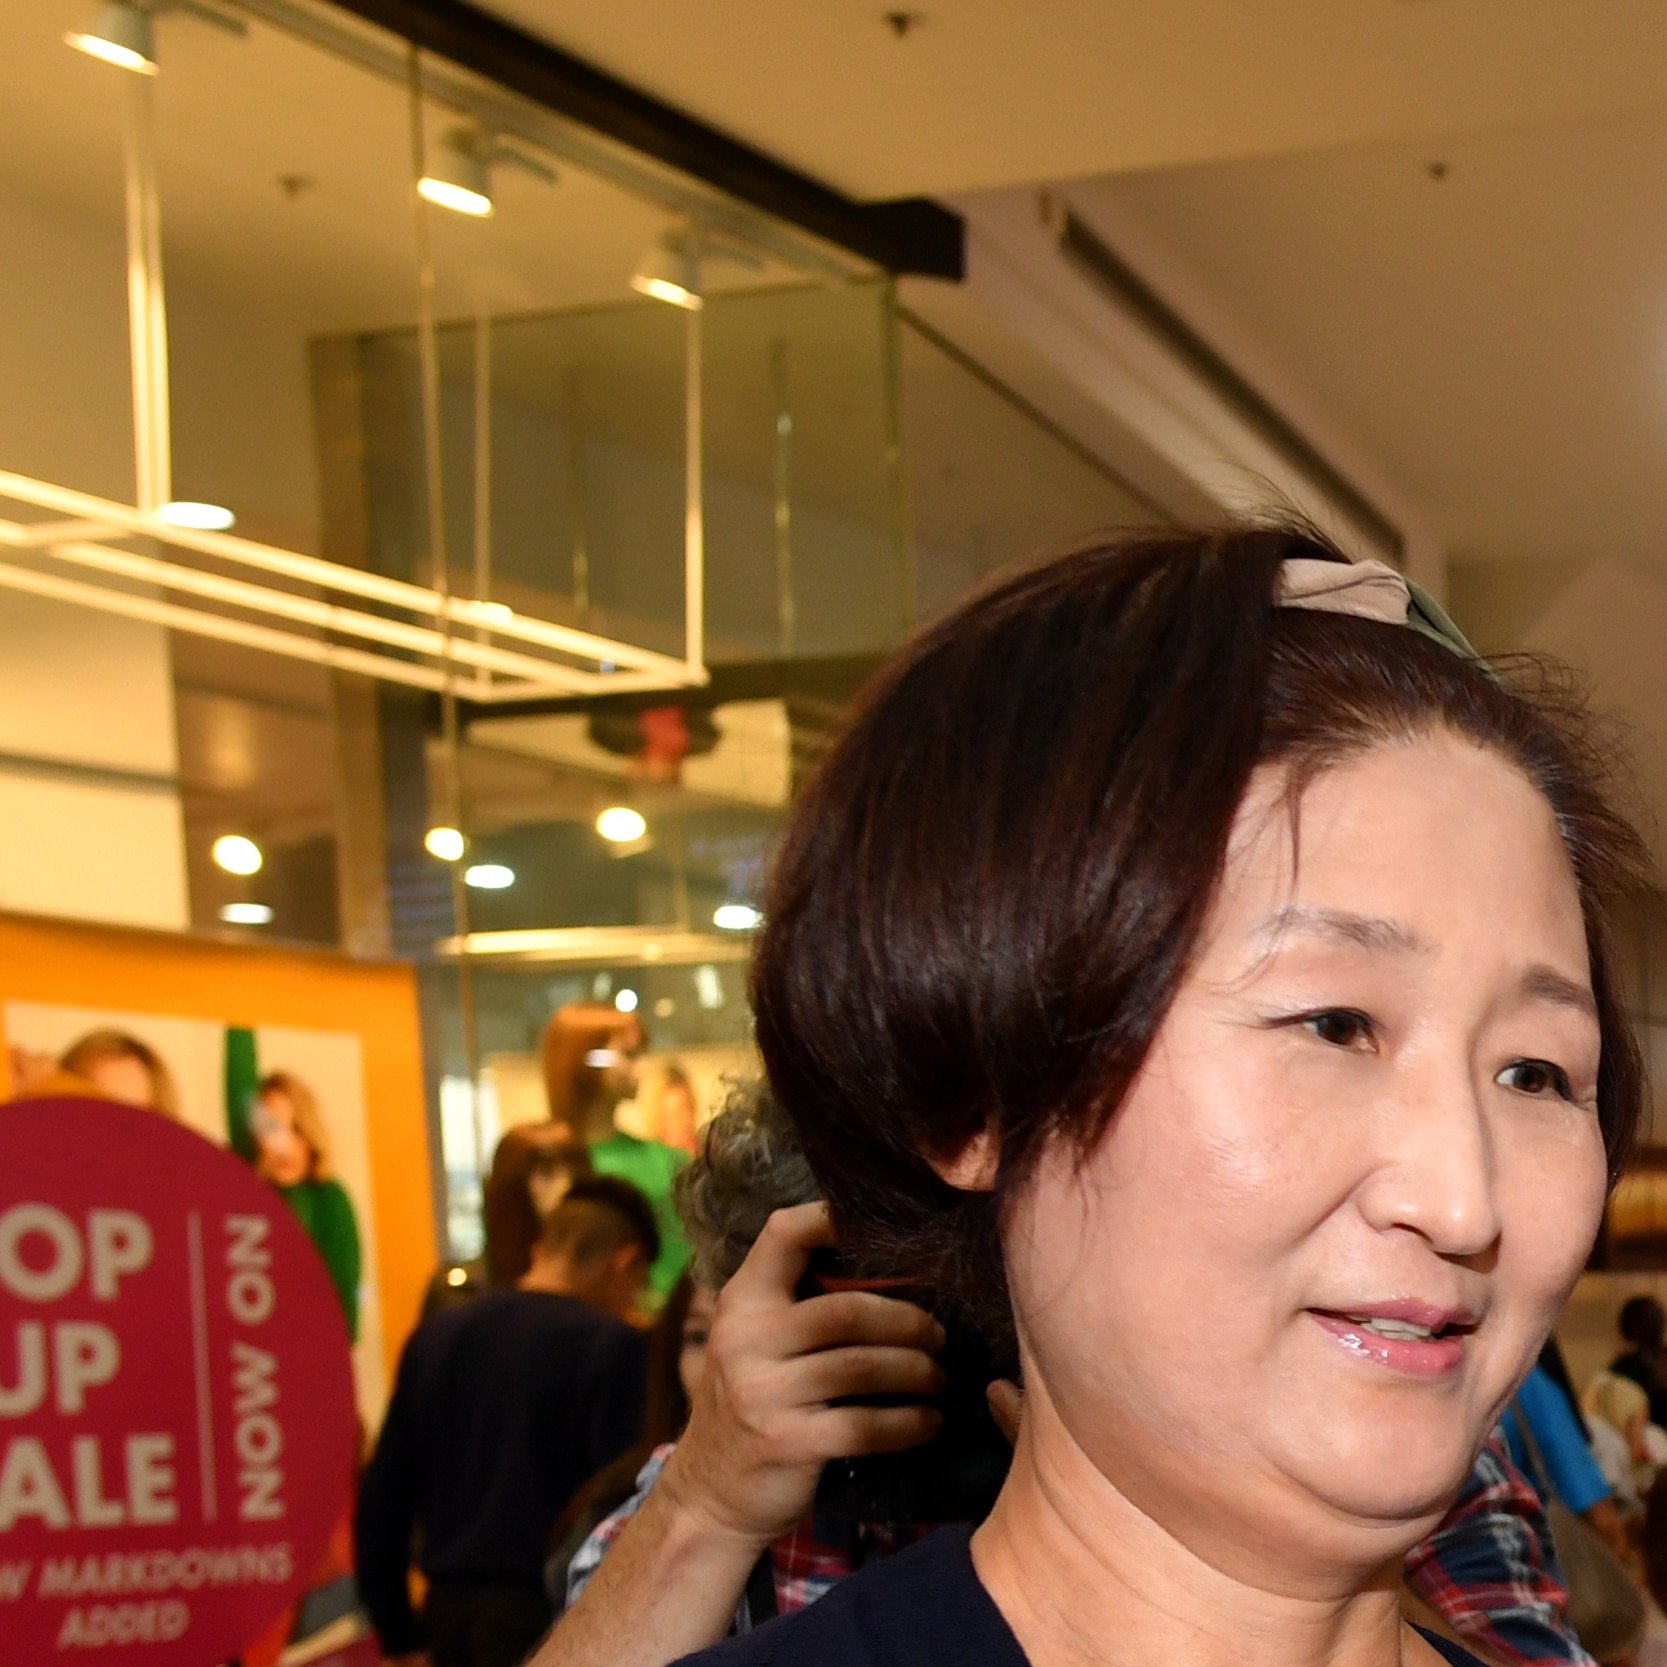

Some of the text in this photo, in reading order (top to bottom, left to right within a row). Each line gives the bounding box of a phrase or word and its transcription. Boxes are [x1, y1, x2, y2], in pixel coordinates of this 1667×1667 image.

[225, 1213, 285, 1521] NOW ON
[38, 1542, 292, 1599] MARKDOWNS
[57, 1600, 190, 1648] ADDED
